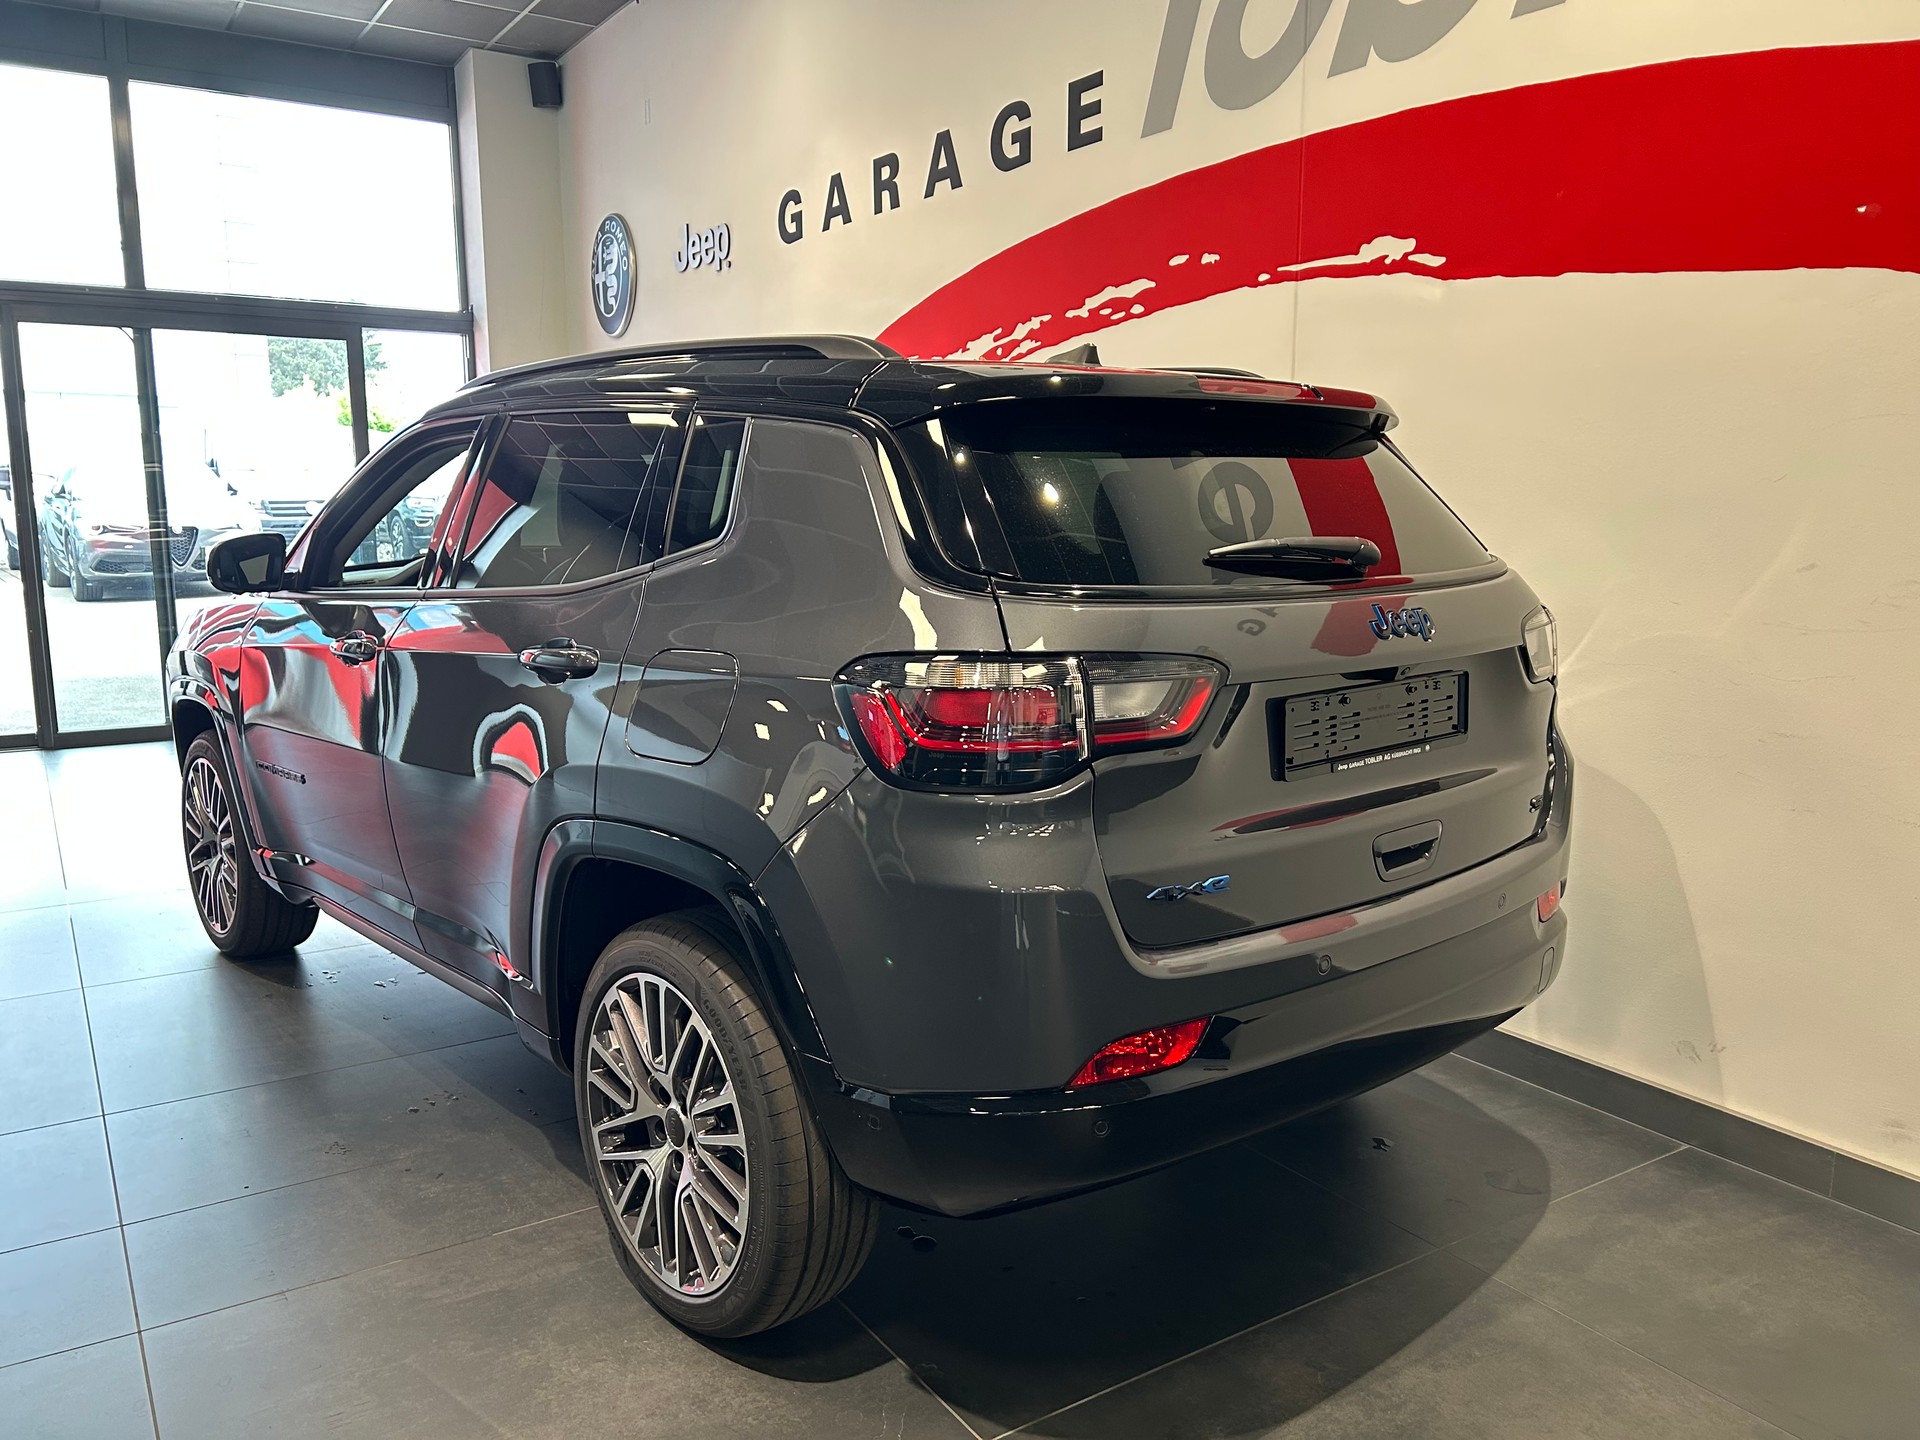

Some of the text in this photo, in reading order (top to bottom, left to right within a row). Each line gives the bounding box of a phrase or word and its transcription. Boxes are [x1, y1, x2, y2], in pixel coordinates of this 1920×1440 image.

[777, 69, 1104, 245] GARAGE
[604, 220, 629, 271] ROMEO
[674, 223, 731, 272] Jeep
[1368, 603, 1436, 642] Jeep
[1349, 760, 1364, 768] GARAGE
[1365, 755, 1383, 764] TOBLER
